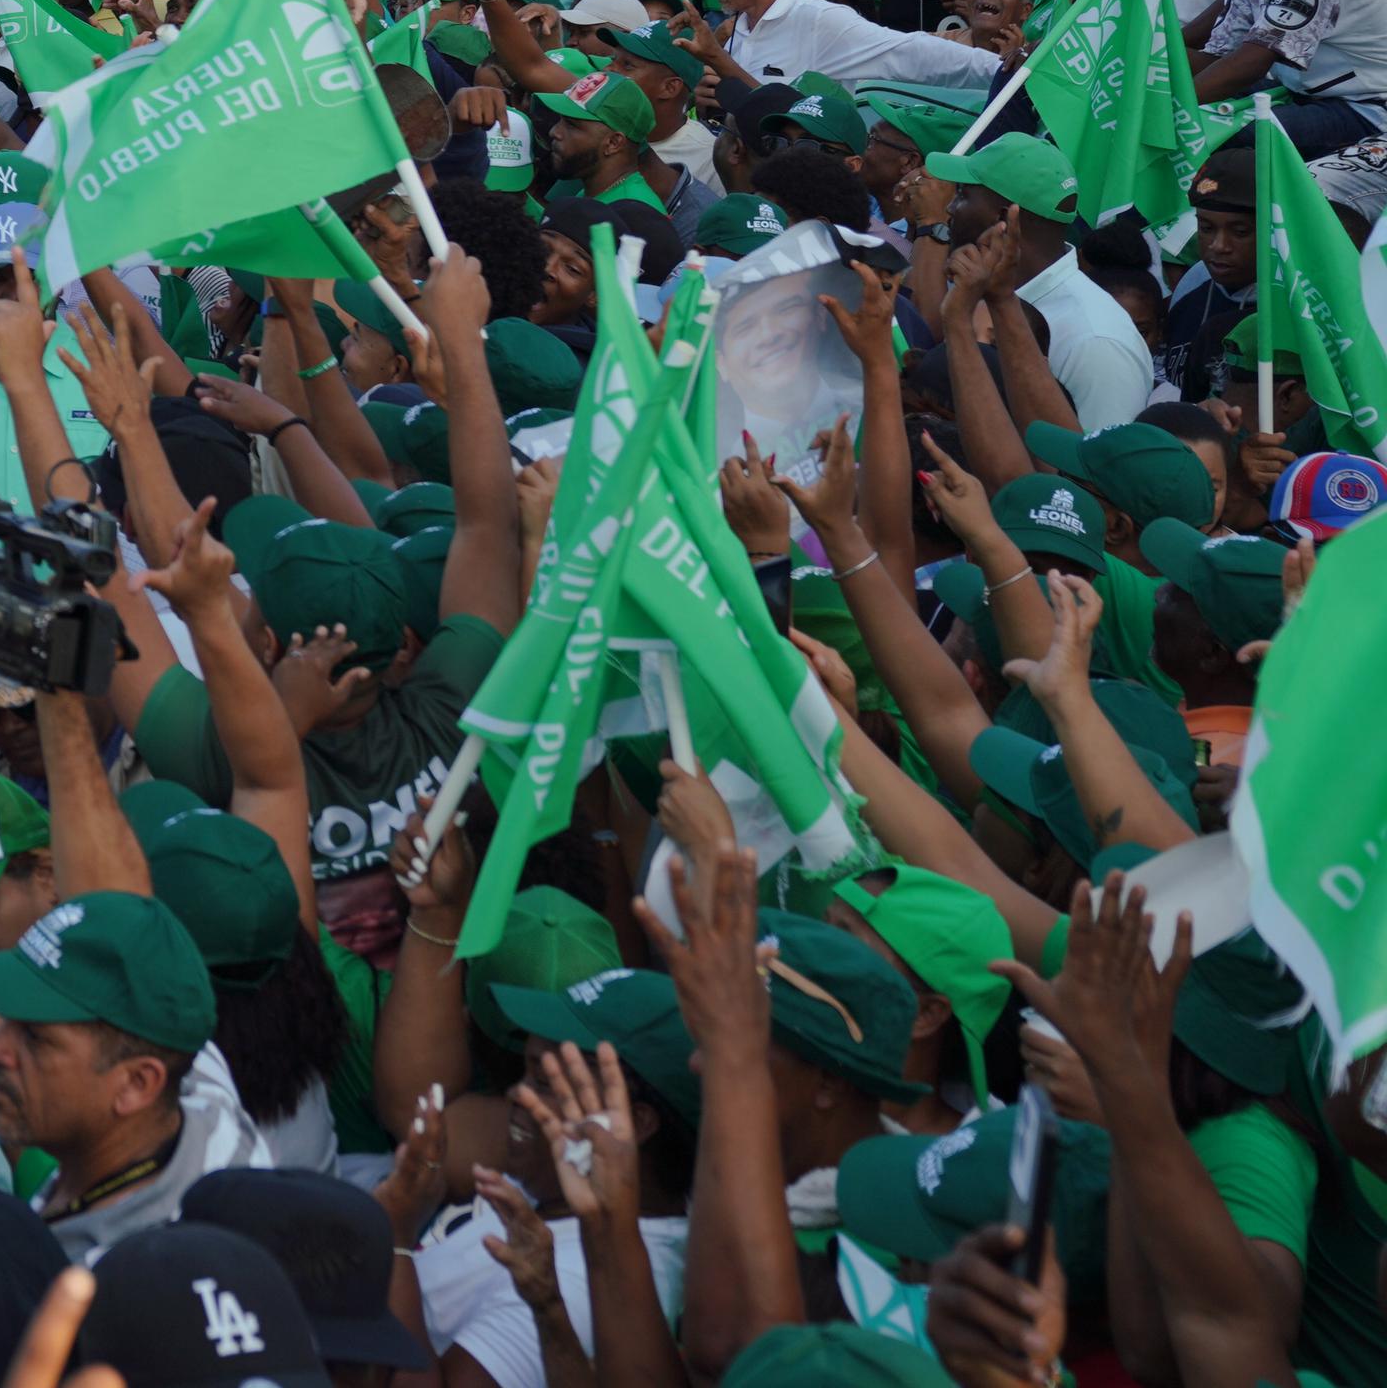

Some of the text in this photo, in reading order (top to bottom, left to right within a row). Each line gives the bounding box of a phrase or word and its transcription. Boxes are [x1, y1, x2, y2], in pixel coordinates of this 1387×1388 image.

[1057, 33, 1090, 77] FP
[1338, 481, 1366, 500] RD
[1030, 508, 1087, 535] LEONEL
[637, 513, 709, 600] DEL
[191, 1276, 267, 1358] LA
